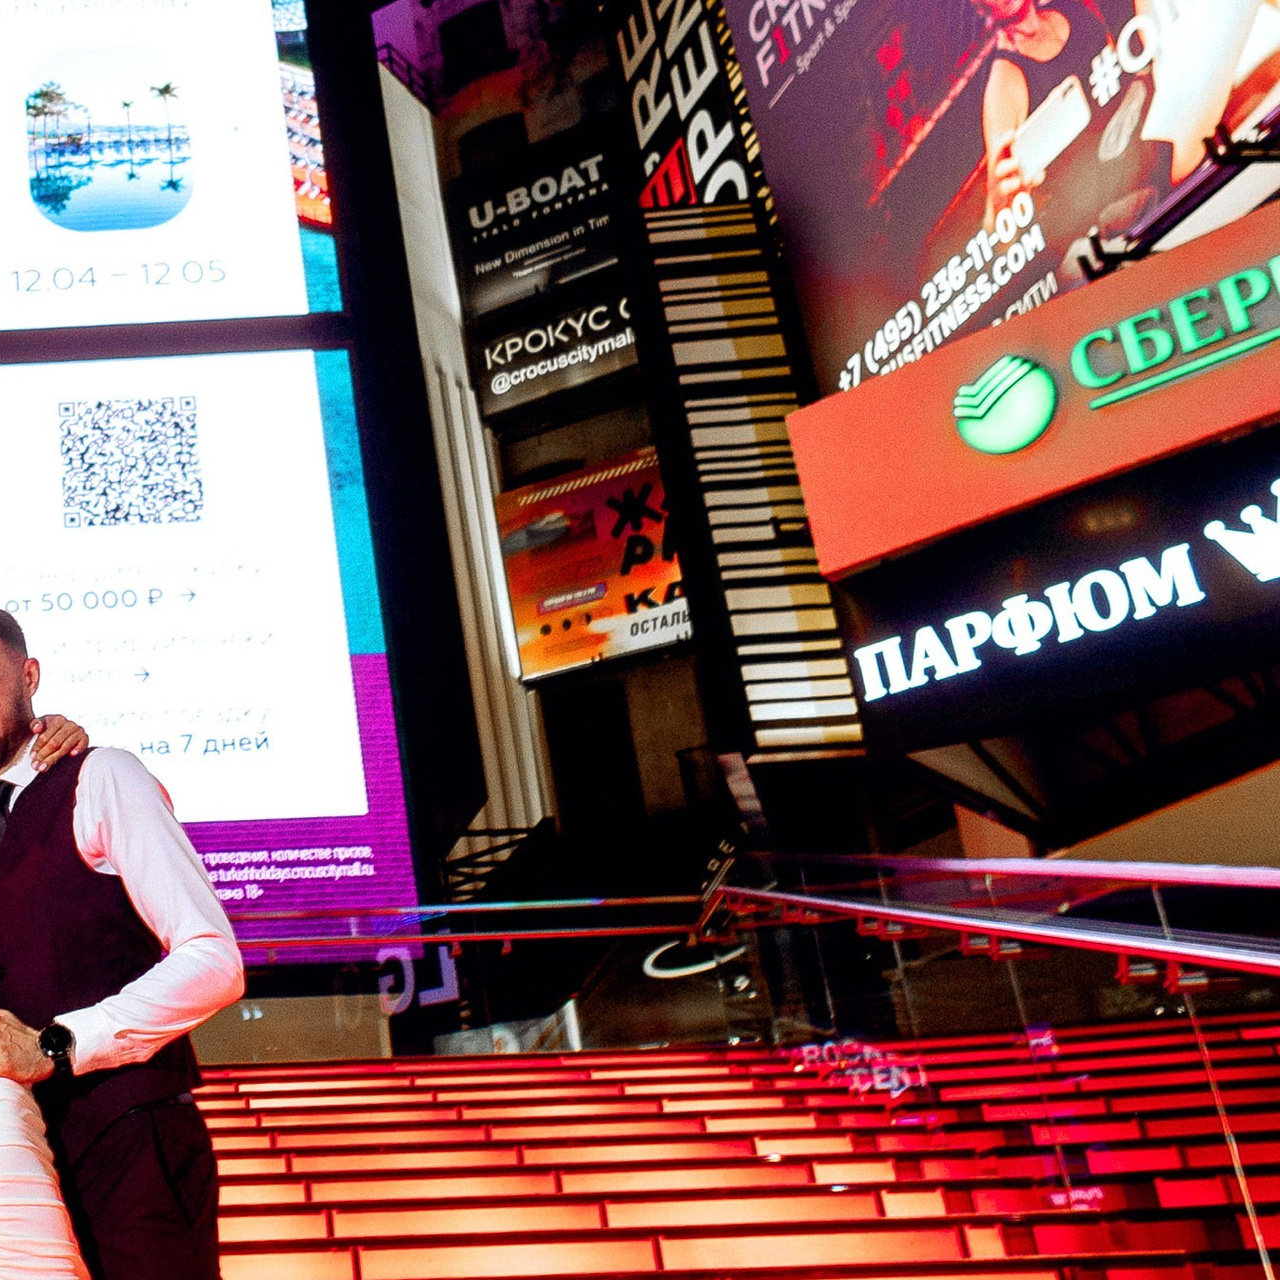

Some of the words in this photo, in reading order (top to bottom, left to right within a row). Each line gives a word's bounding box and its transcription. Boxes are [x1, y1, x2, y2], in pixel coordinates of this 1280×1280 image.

[469, 154, 604, 228] U-BOAT
[532, 183, 609, 219] FONTANA
[11, 266, 98, 292] 12.04
[141, 260, 227, 286] 12.05
[475, 257, 502, 275] New
[505, 231, 570, 265] Dimension
[573, 222, 586, 237] in
[838, 349, 863, 392] +7
[864, 300, 923, 375] (495)
[921, 190, 1036, 319] 236-11-00
[485, 305, 612, 370] КРОКУС
[1070, 256, 1280, 390] СБЕР
[5, 596, 32, 615] от
[41, 592, 75, 613] 50
[82, 588, 139, 611] 000
[854, 543, 1206, 702] ПАРФЮМ
[140, 740, 171, 756] на
[180, 734, 194, 754] 7
[203, 730, 270, 757] дней
